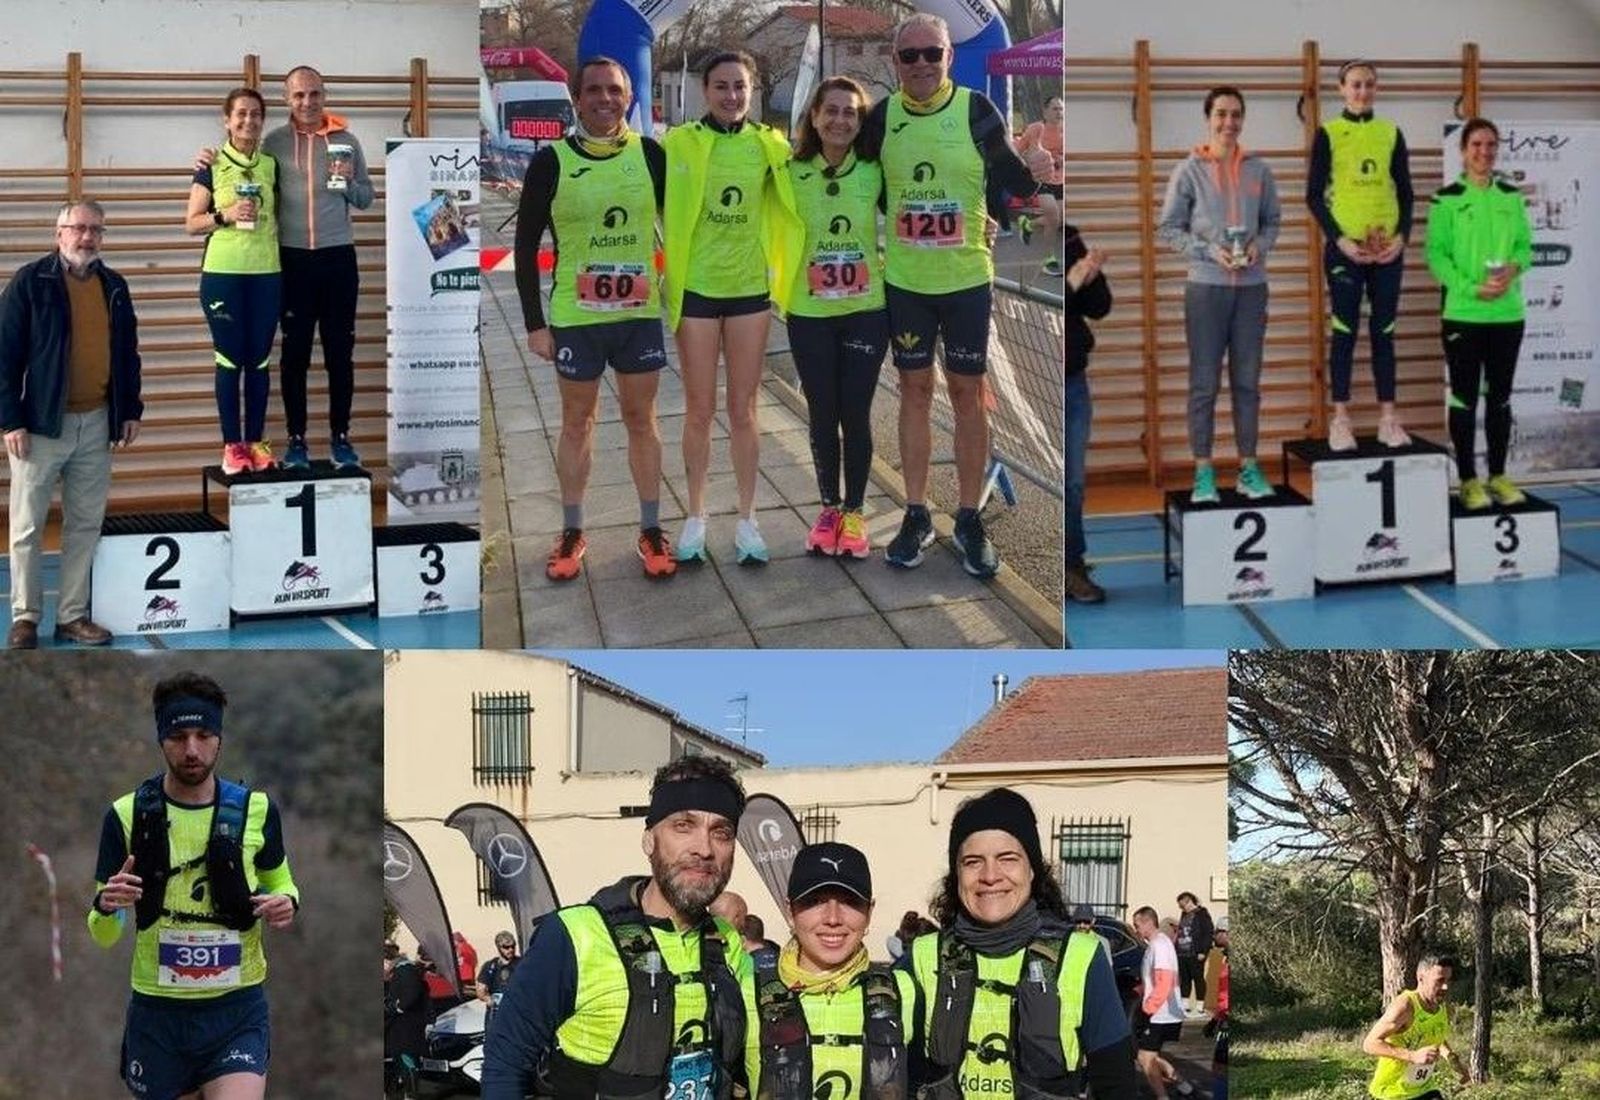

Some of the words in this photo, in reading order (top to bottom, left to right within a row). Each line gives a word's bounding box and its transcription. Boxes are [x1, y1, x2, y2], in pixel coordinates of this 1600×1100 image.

[900, 188, 947, 201] Adarsa
[707, 211, 748, 224] Adarsa
[900, 212, 956, 236] 120
[589, 233, 638, 249] Adarsa
[595, 274, 634, 299] 60
[822, 263, 857, 288] 30
[1365, 460, 1396, 528] 1
[285, 484, 317, 556] 1
[1233, 511, 1267, 561] 2
[1494, 515, 1520, 554] 3
[145, 536, 180, 590] 2
[420, 543, 446, 586] 3
[176, 946, 220, 968] 391
